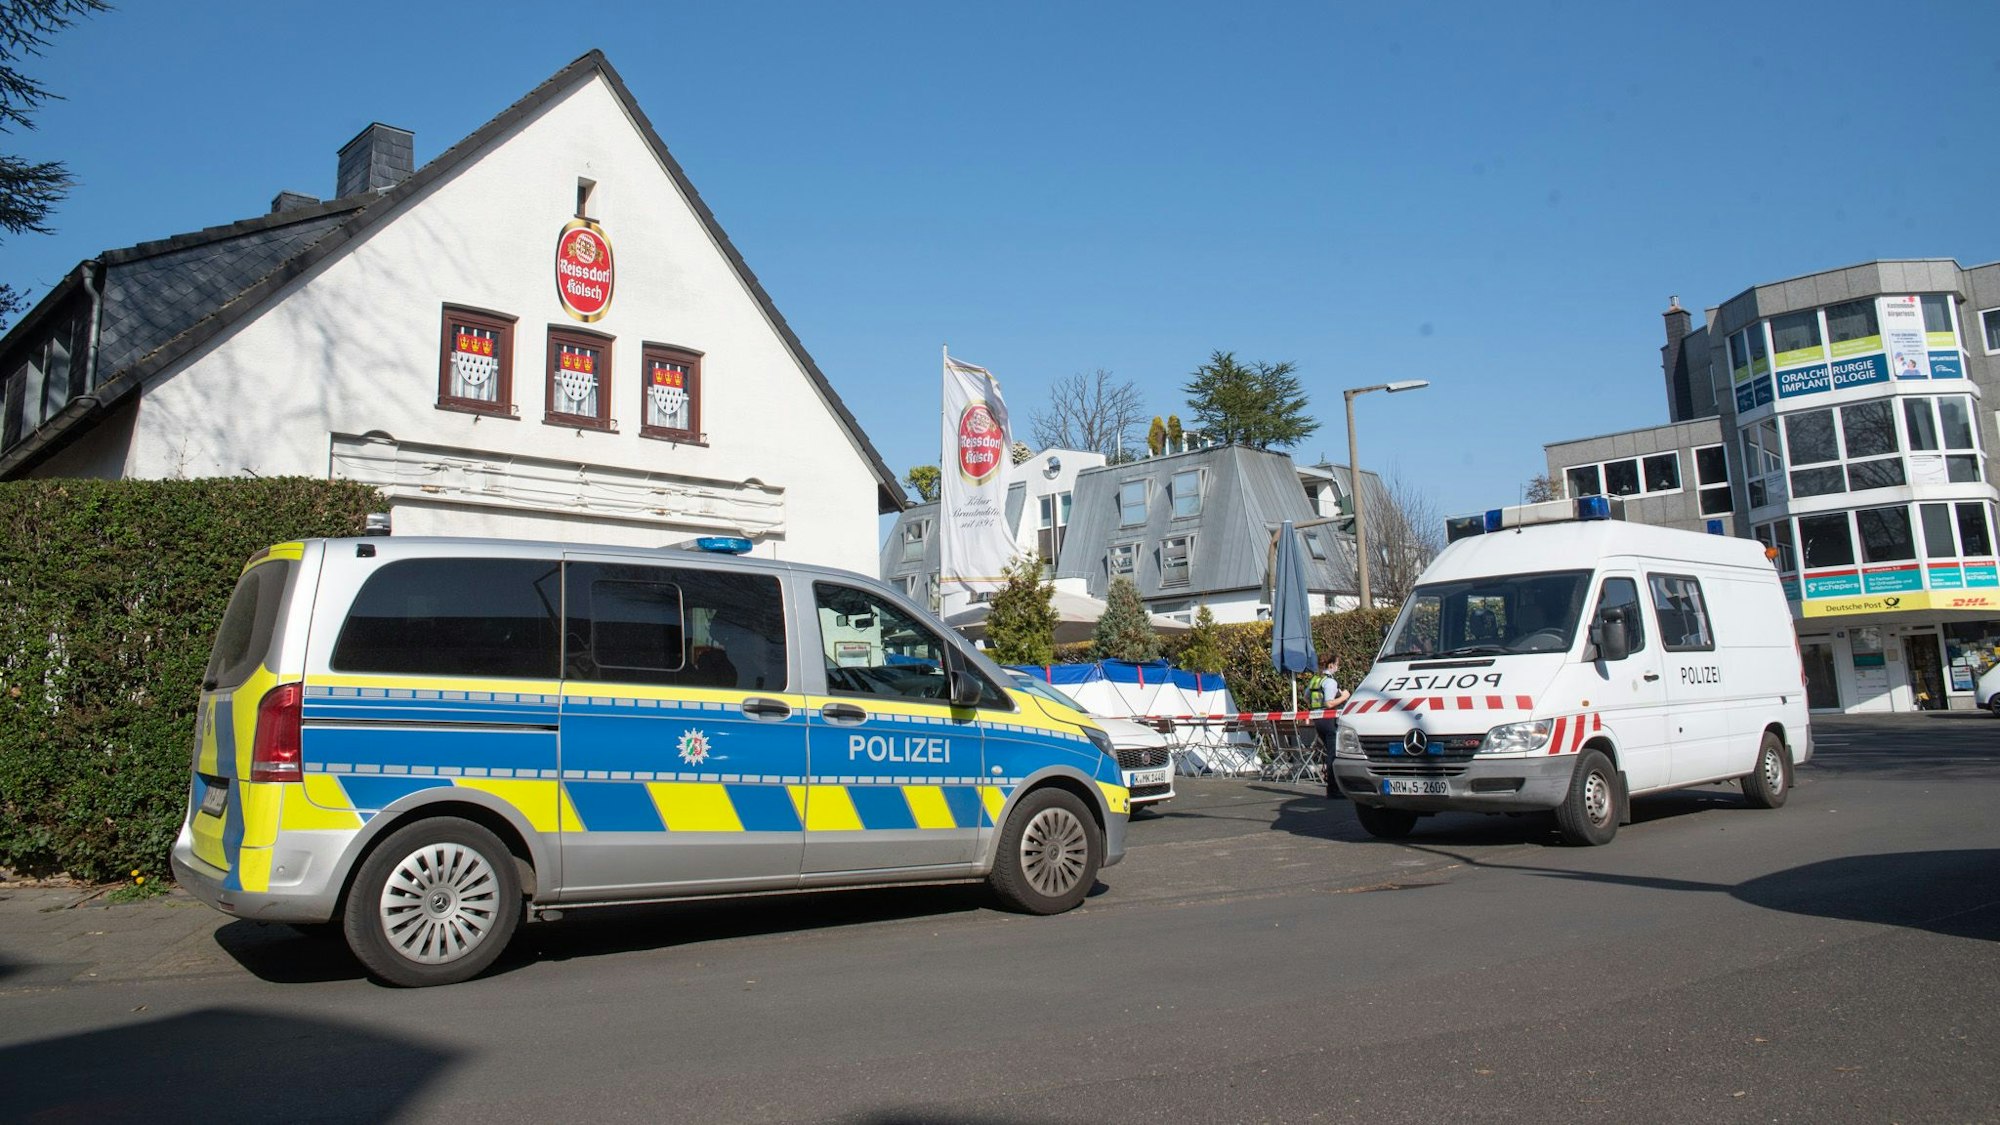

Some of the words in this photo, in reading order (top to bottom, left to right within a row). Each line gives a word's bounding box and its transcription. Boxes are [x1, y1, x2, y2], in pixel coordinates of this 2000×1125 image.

[560, 259, 610, 282] Reissdorf
[567, 279, 602, 302] Kölsch
[960, 435, 1001, 450] Reissdorf
[1818, 582, 1859, 592] schepers
[1826, 604, 1862, 612] Deutsche
[1953, 598, 1989, 607] DHL
[1680, 666, 1721, 685] POLIZEI
[849, 735, 950, 763] POLIZEI
[1390, 781, 1407, 794] NRW
